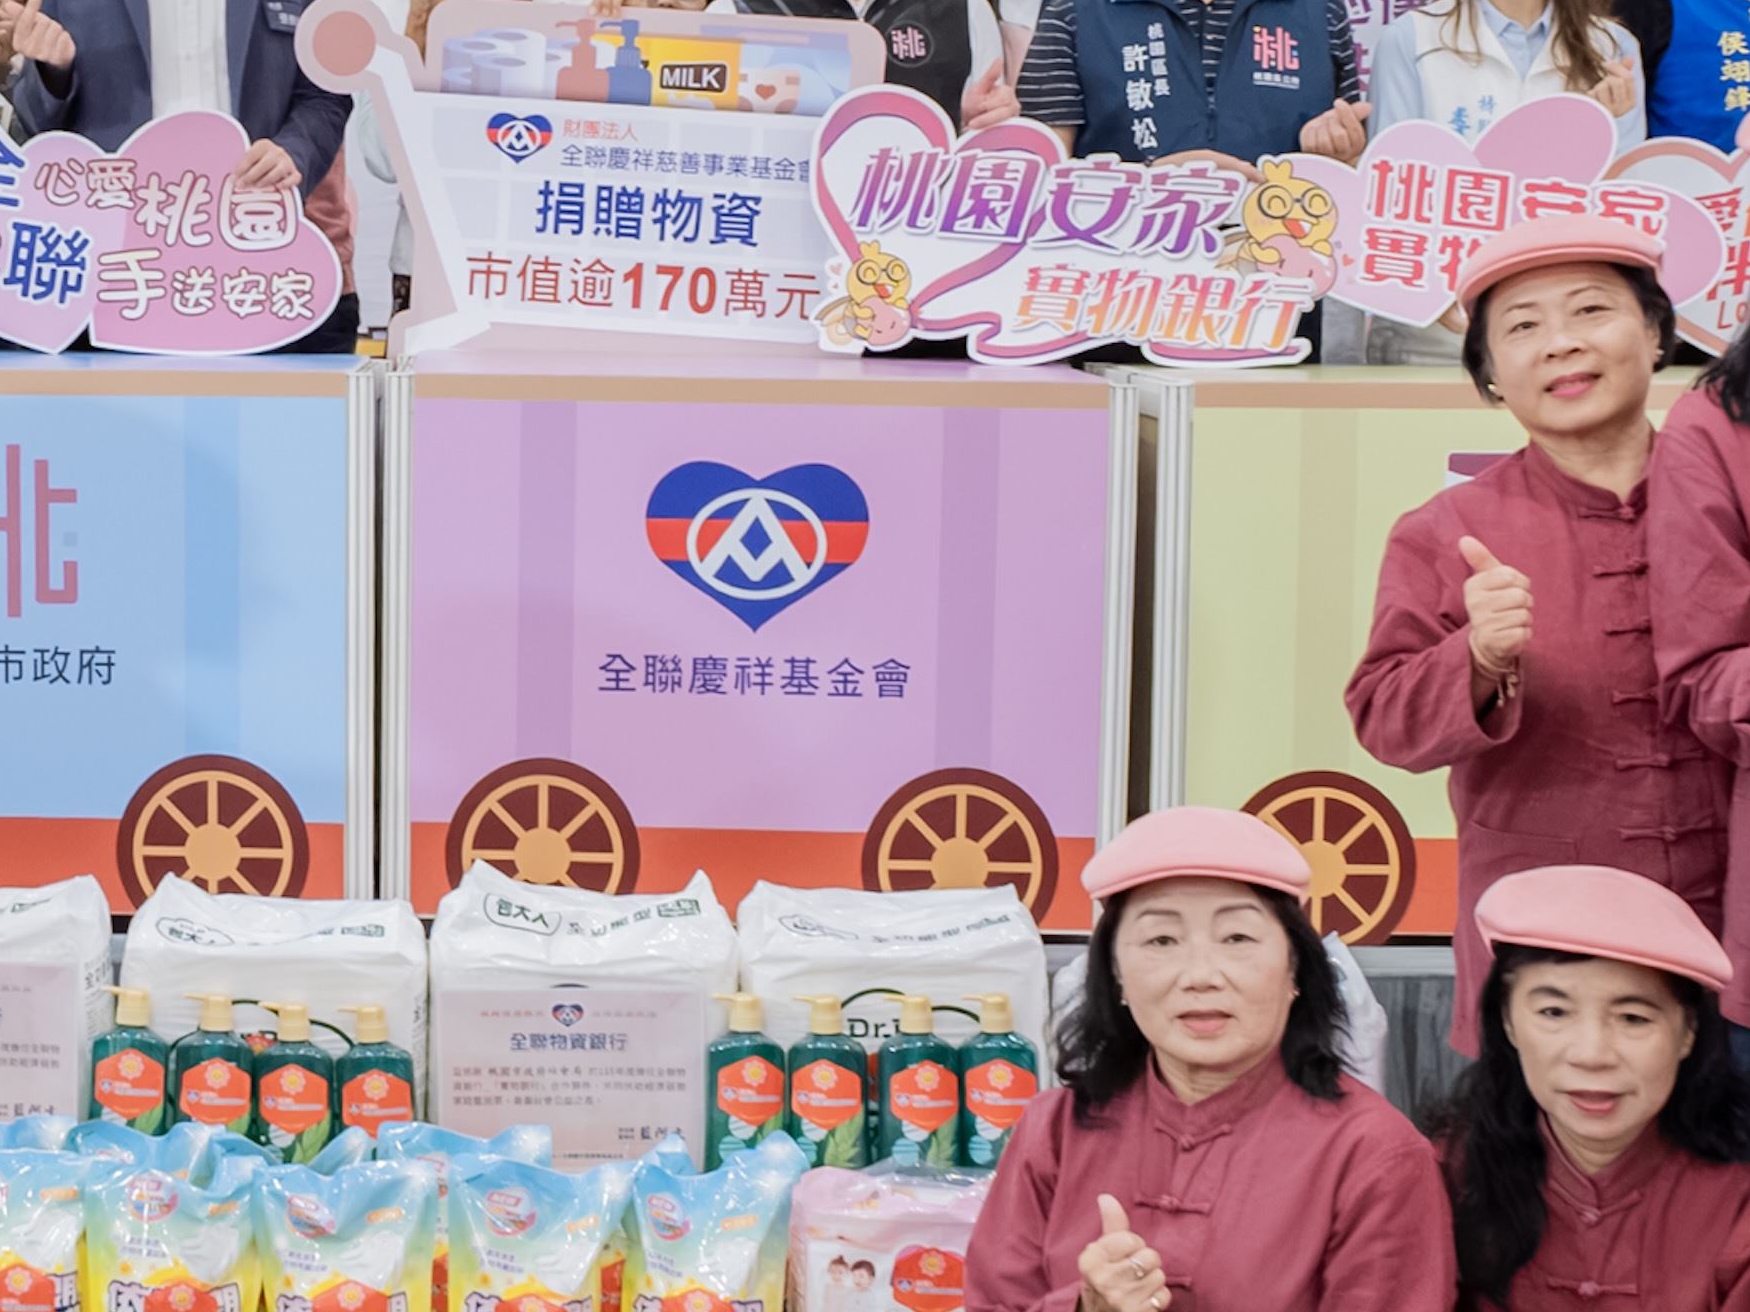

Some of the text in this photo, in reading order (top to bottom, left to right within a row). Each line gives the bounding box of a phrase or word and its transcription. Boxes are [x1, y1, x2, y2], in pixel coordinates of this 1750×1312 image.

[662, 65, 721, 91] MILK
[1122, 44, 1158, 150] 許敏松
[562, 118, 638, 141] 財團法人
[535, 180, 763, 247] 捐贈物資
[853, 145, 1240, 257] 桃園安家
[3, 221, 314, 321] 聯手送安家
[466, 250, 822, 321] 市值逾170萬元
[1013, 262, 1320, 354] 實物銀行
[598, 653, 912, 698] 全聯慶祥基金會
[511, 1033, 628, 1052] 全聯物資銀行
